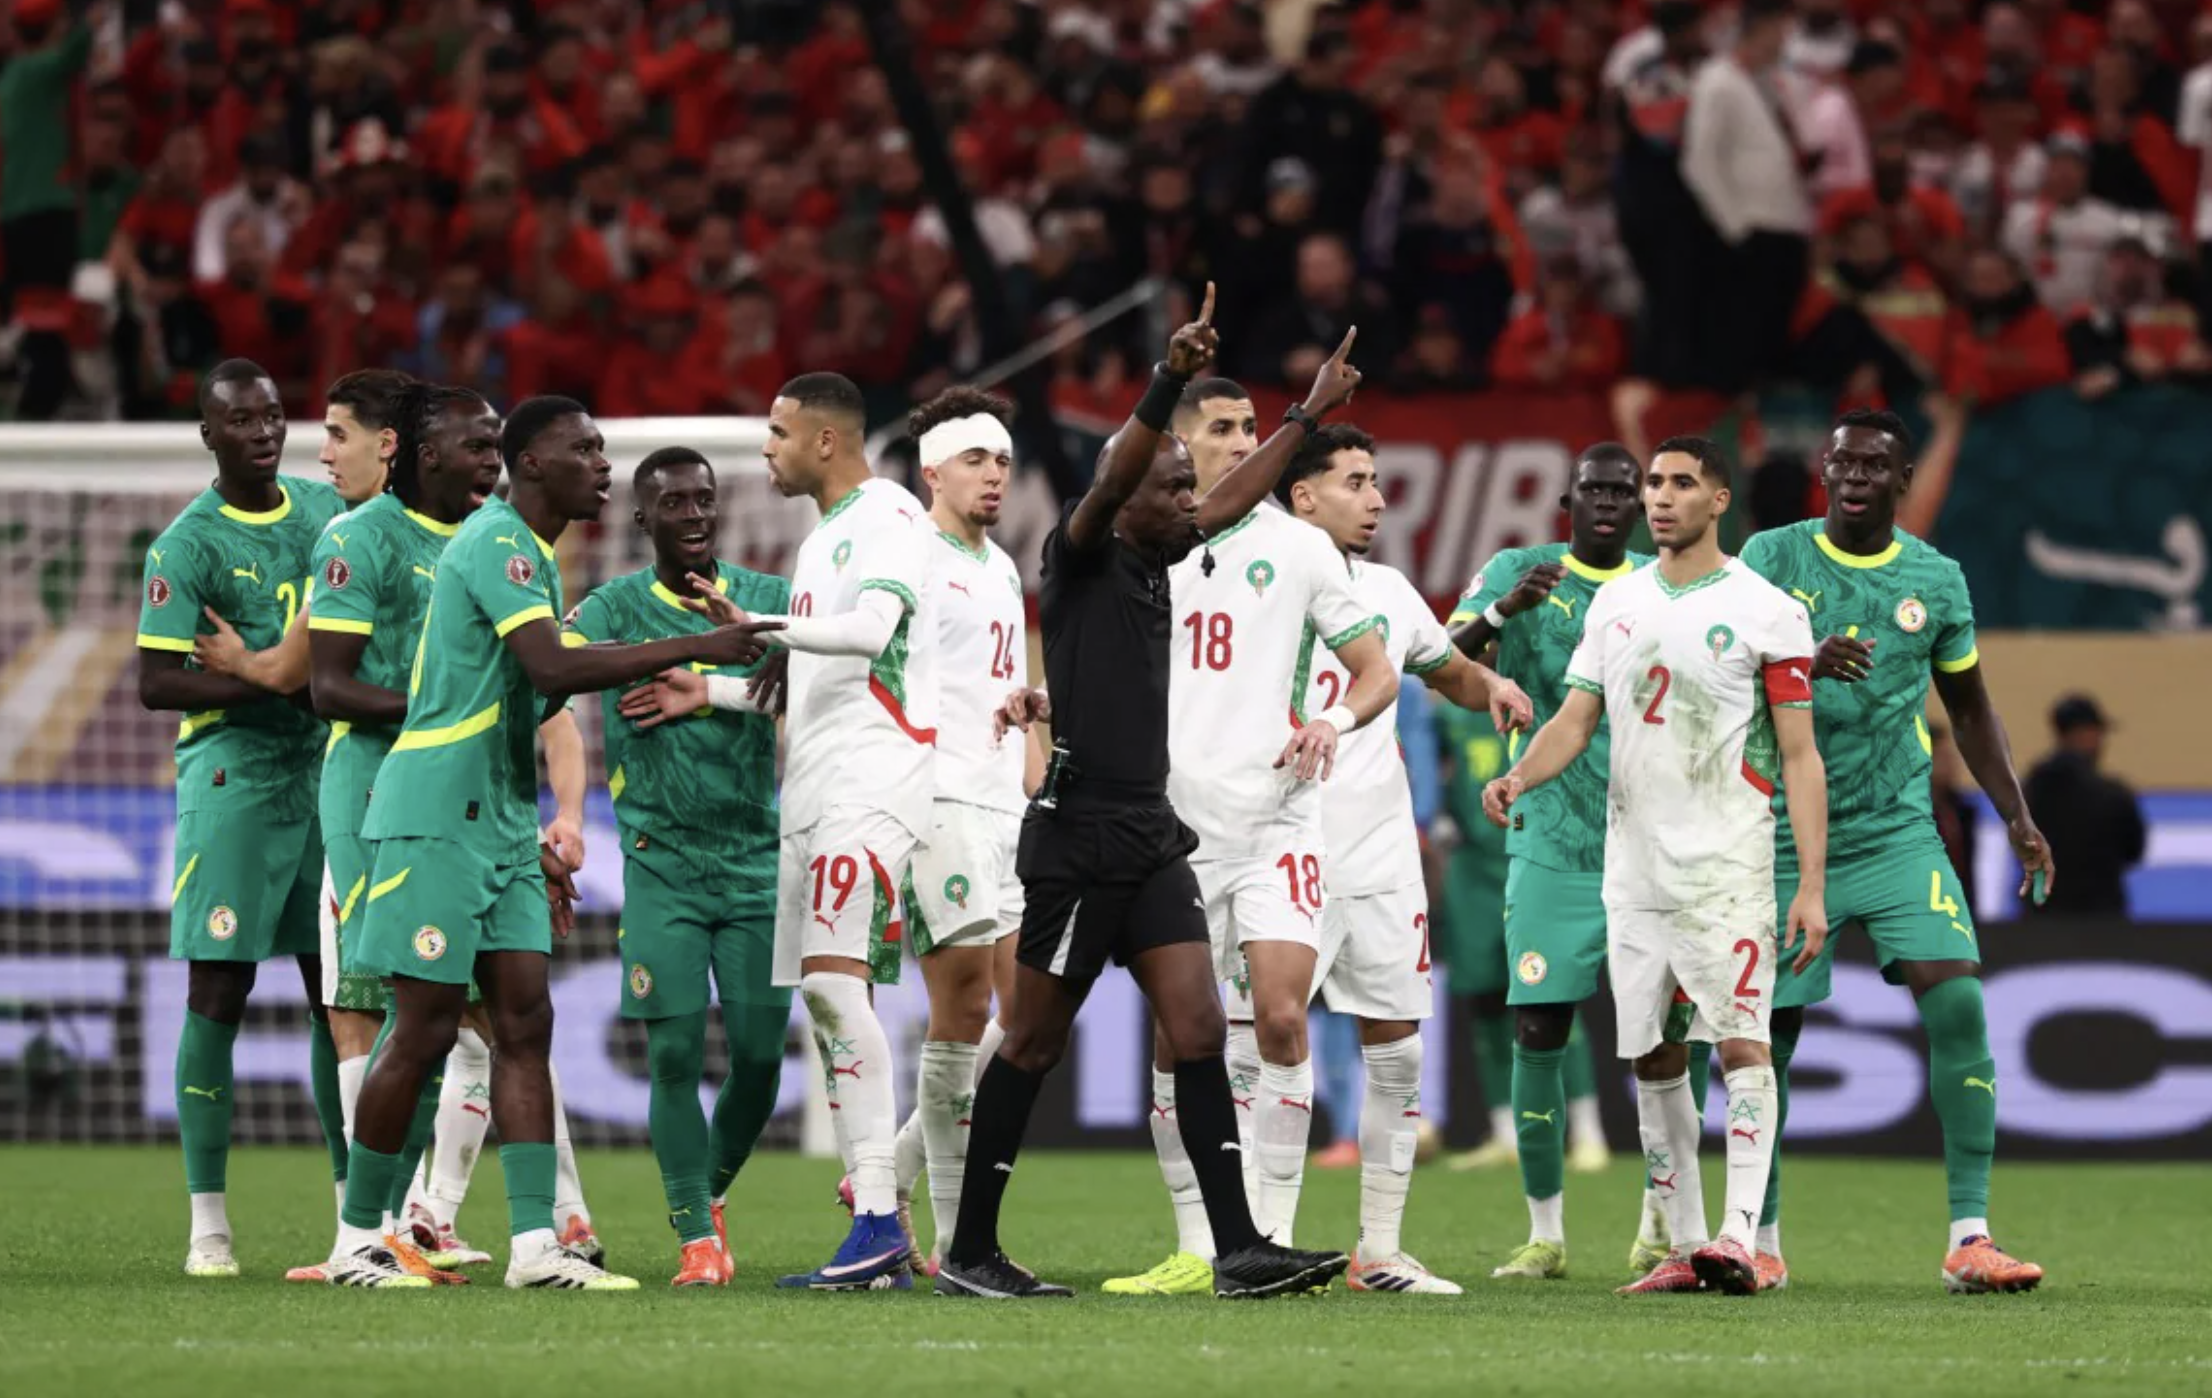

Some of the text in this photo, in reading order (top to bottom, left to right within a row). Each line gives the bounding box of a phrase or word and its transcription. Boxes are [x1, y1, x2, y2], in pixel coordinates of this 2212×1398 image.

[990, 620, 1015, 681] 24
[1183, 611, 1233, 671] 18
[1317, 670, 1358, 711] 2
[1643, 665, 1671, 726] 2
[809, 854, 858, 912] 19
[1276, 852, 1322, 908] 18
[1930, 870, 1959, 918] 4
[1733, 938, 1760, 998] 2
